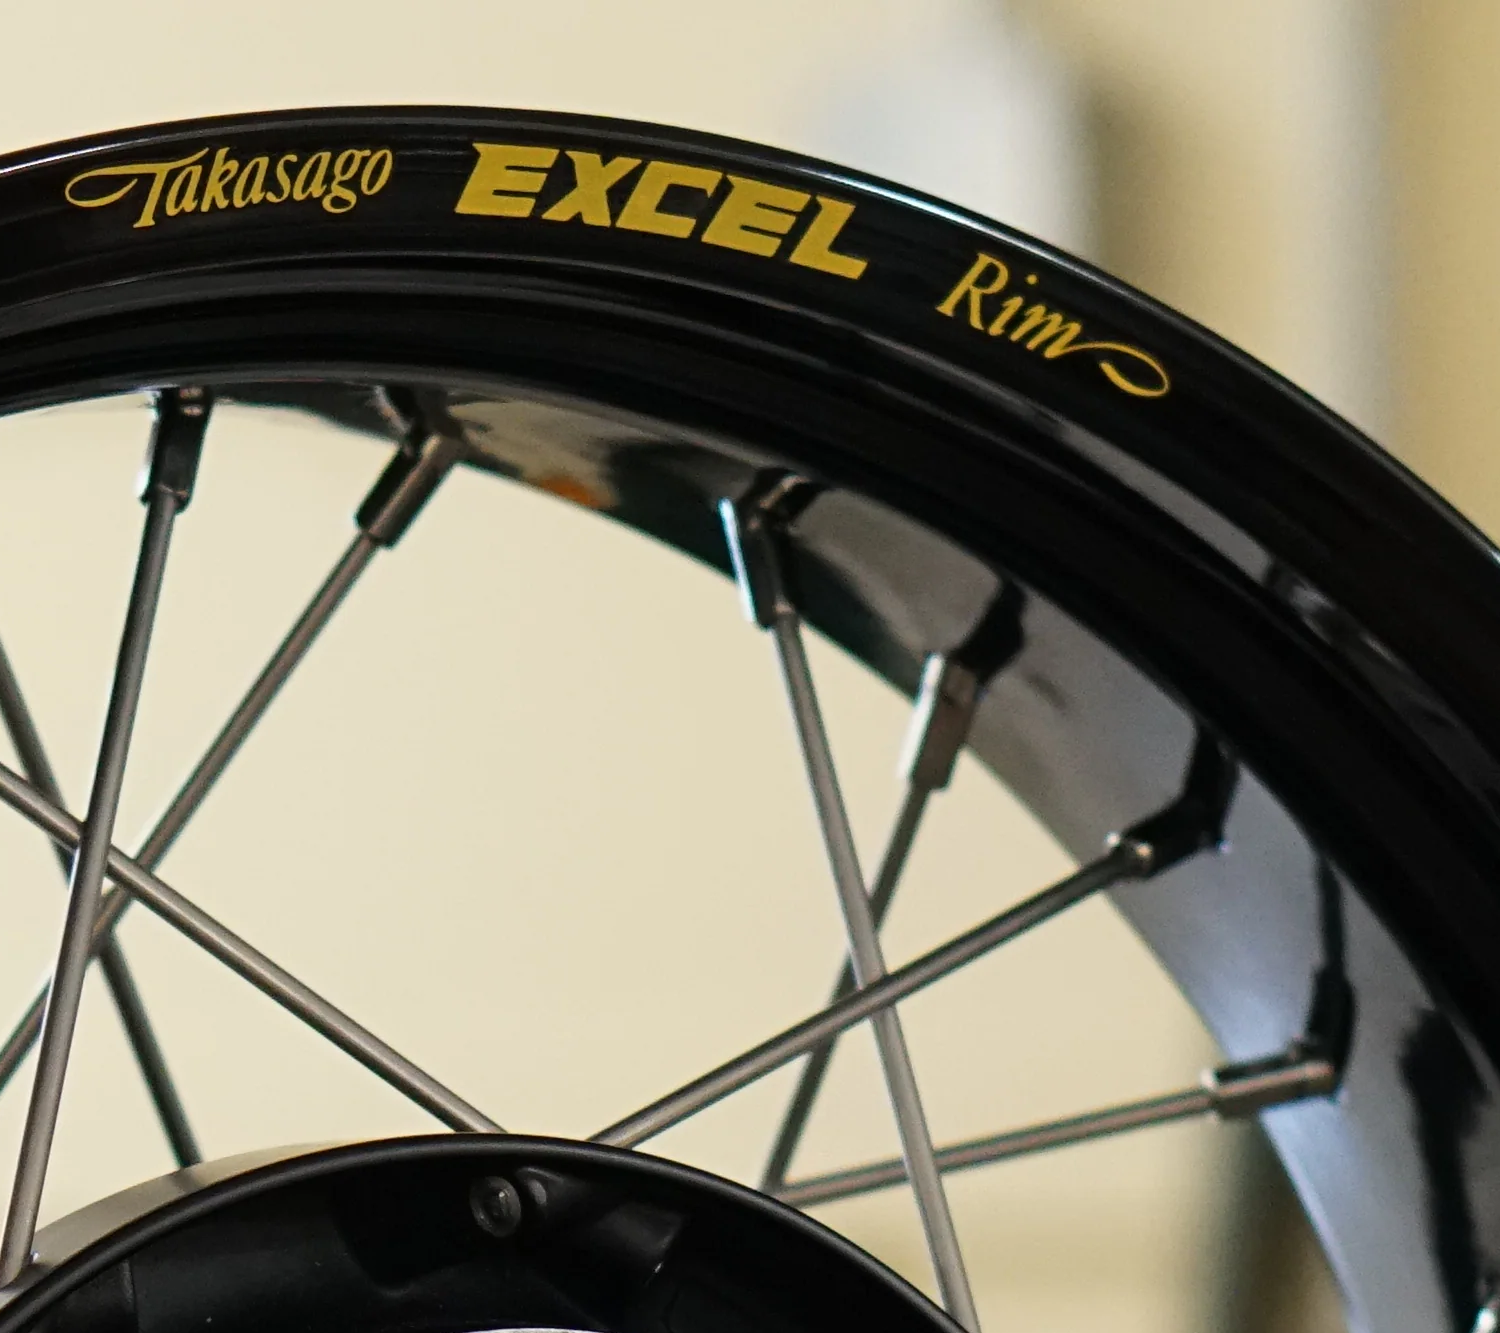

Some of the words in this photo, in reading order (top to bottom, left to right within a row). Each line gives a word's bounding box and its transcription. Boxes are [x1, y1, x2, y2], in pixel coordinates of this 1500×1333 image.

[63, 145, 394, 228] Takasago
[454, 141, 868, 279] EXCEL
[935, 252, 1172, 398] Rim
